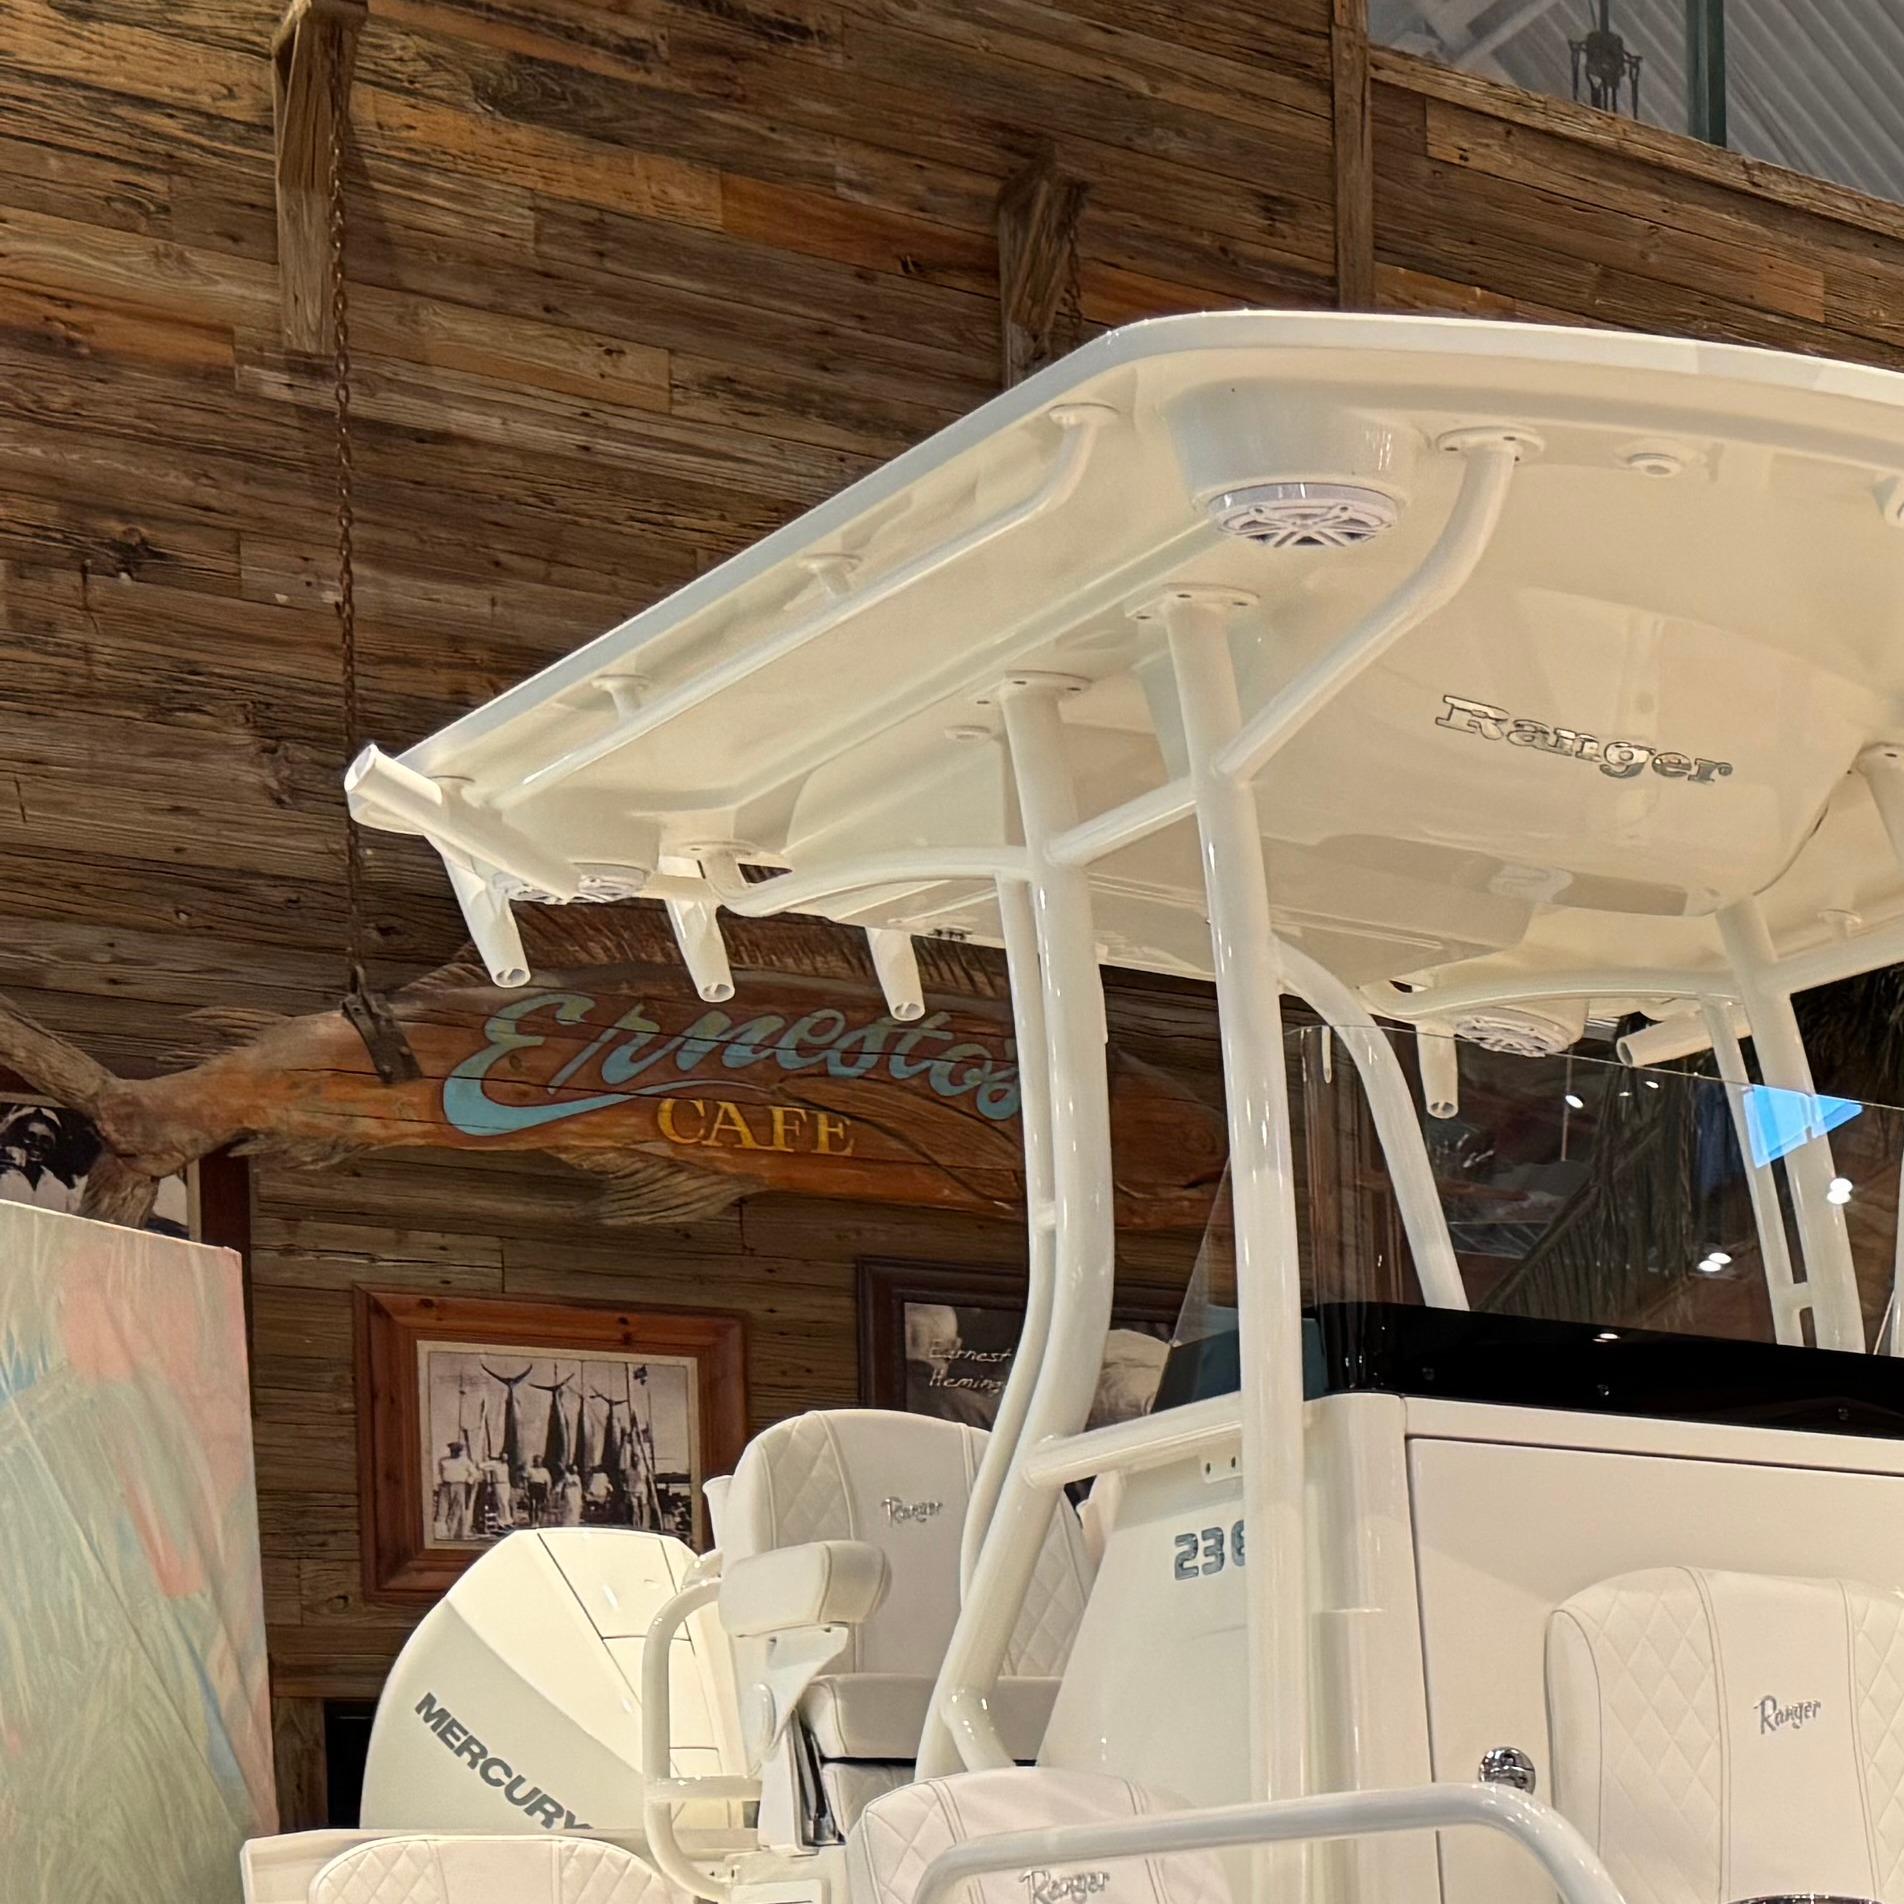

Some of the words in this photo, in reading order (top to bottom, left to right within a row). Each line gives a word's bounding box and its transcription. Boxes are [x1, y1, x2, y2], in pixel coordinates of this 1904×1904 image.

[1436, 694, 1733, 786] Ranger
[658, 1098, 853, 1156] CAFE
[881, 1496, 943, 1528] Ranger
[1753, 1695, 1821, 1735] Ranger
[414, 1693, 595, 1830] MERCURY
